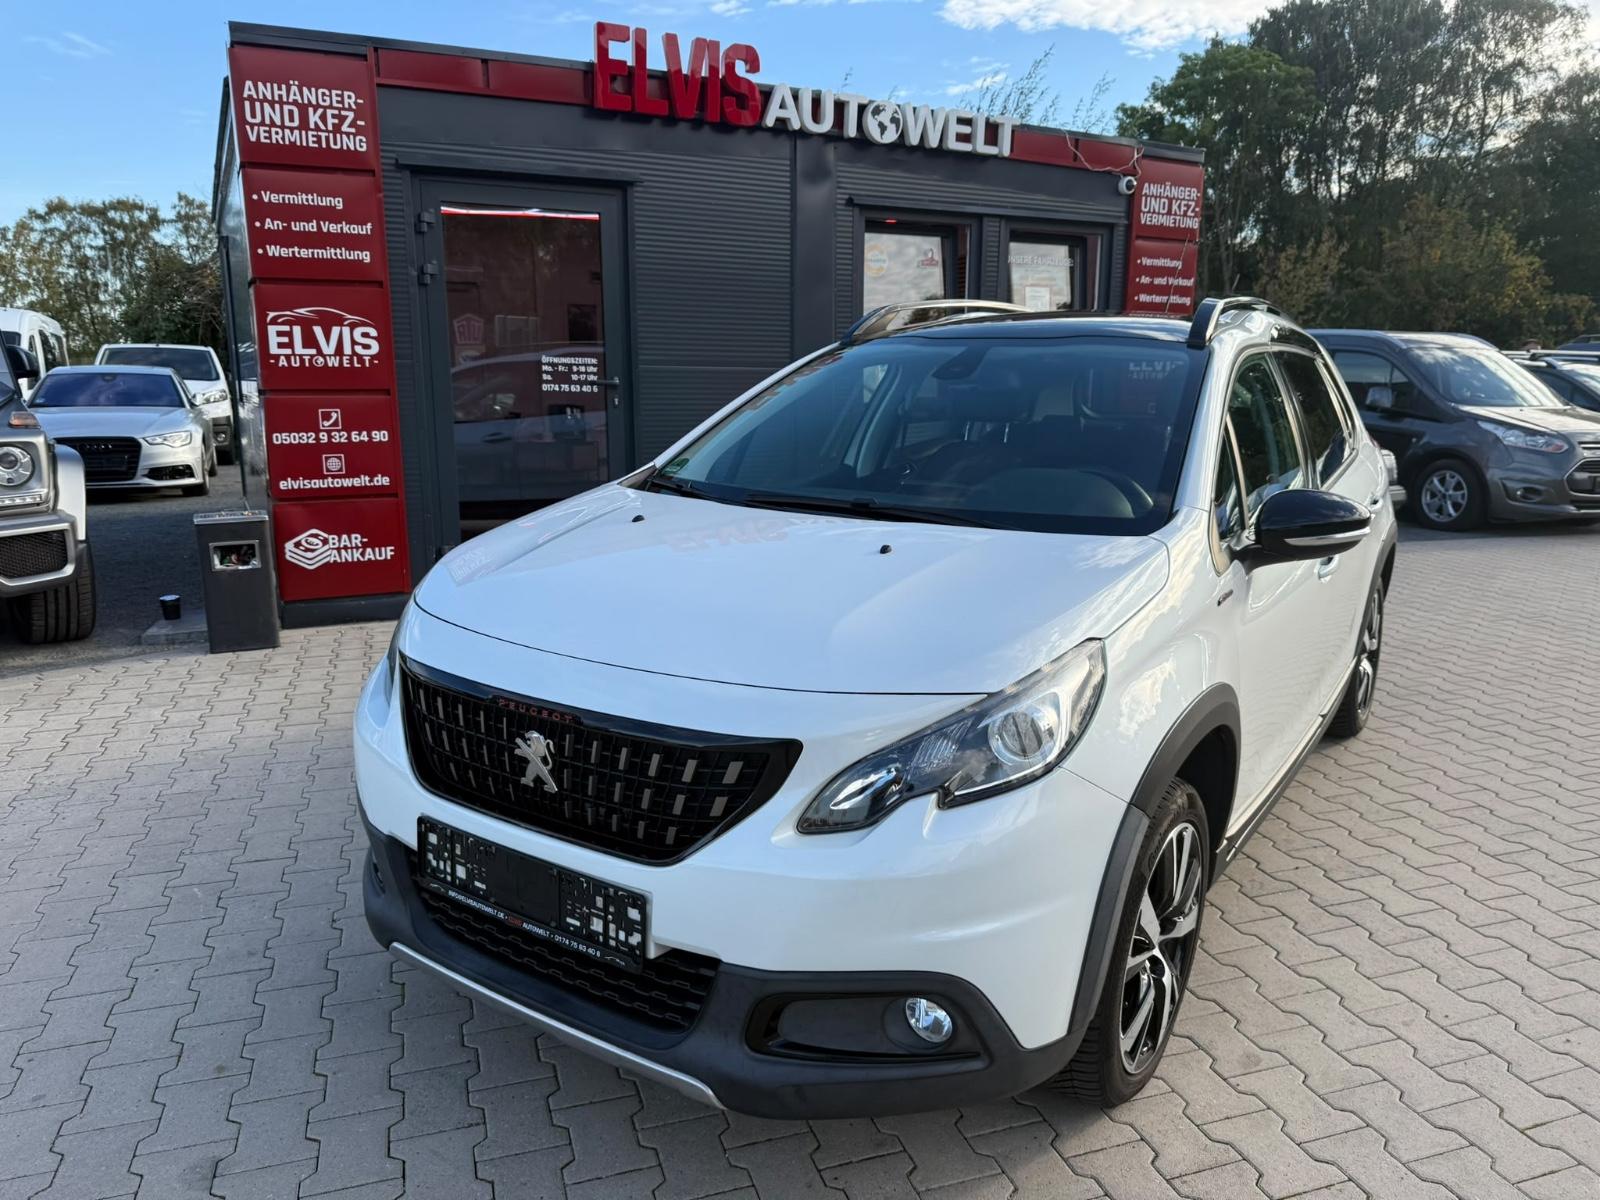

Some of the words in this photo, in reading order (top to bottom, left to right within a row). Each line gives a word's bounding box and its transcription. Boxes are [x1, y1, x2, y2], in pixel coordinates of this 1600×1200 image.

[593, 21, 762, 127] ELVIS
[243, 80, 364, 109] ANHÄNGER-
[244, 101, 300, 128] UND
[308, 107, 366, 133] KFZ-
[761, 82, 1019, 157] AUTOWELT
[245, 125, 367, 152] VERMIETUNG
[1142, 182, 1200, 200] ANHÄNGER-
[261, 191, 343, 209] Vermittlung
[1141, 197, 1168, 213] UND
[1171, 200, 1199, 216] KFZ-
[264, 218, 287, 230] An-
[291, 220, 317, 232] und
[320, 221, 373, 235] Verkauf
[1140, 213, 1199, 229] VERMIETUNG
[266, 245, 371, 262] Wertermittlung
[1141, 257, 1182, 269] Vermittlung
[1153, 276, 1167, 285] und
[267, 325, 380, 356] ELVIS
[561, 384, 570, 392] 75
[273, 432, 316, 444] 05032
[320, 432, 328, 443] 9
[331, 431, 348, 443] 32
[351, 431, 369, 442] 64
[372, 430, 389, 442] 90
[279, 474, 390, 490] elvisautowelt.de
[328, 534, 368, 548] BAR-
[329, 546, 395, 563] ANKAUF
[499, 699, 573, 722] PEUGEOT
[522, 922, 549, 938] AUTOWELT
